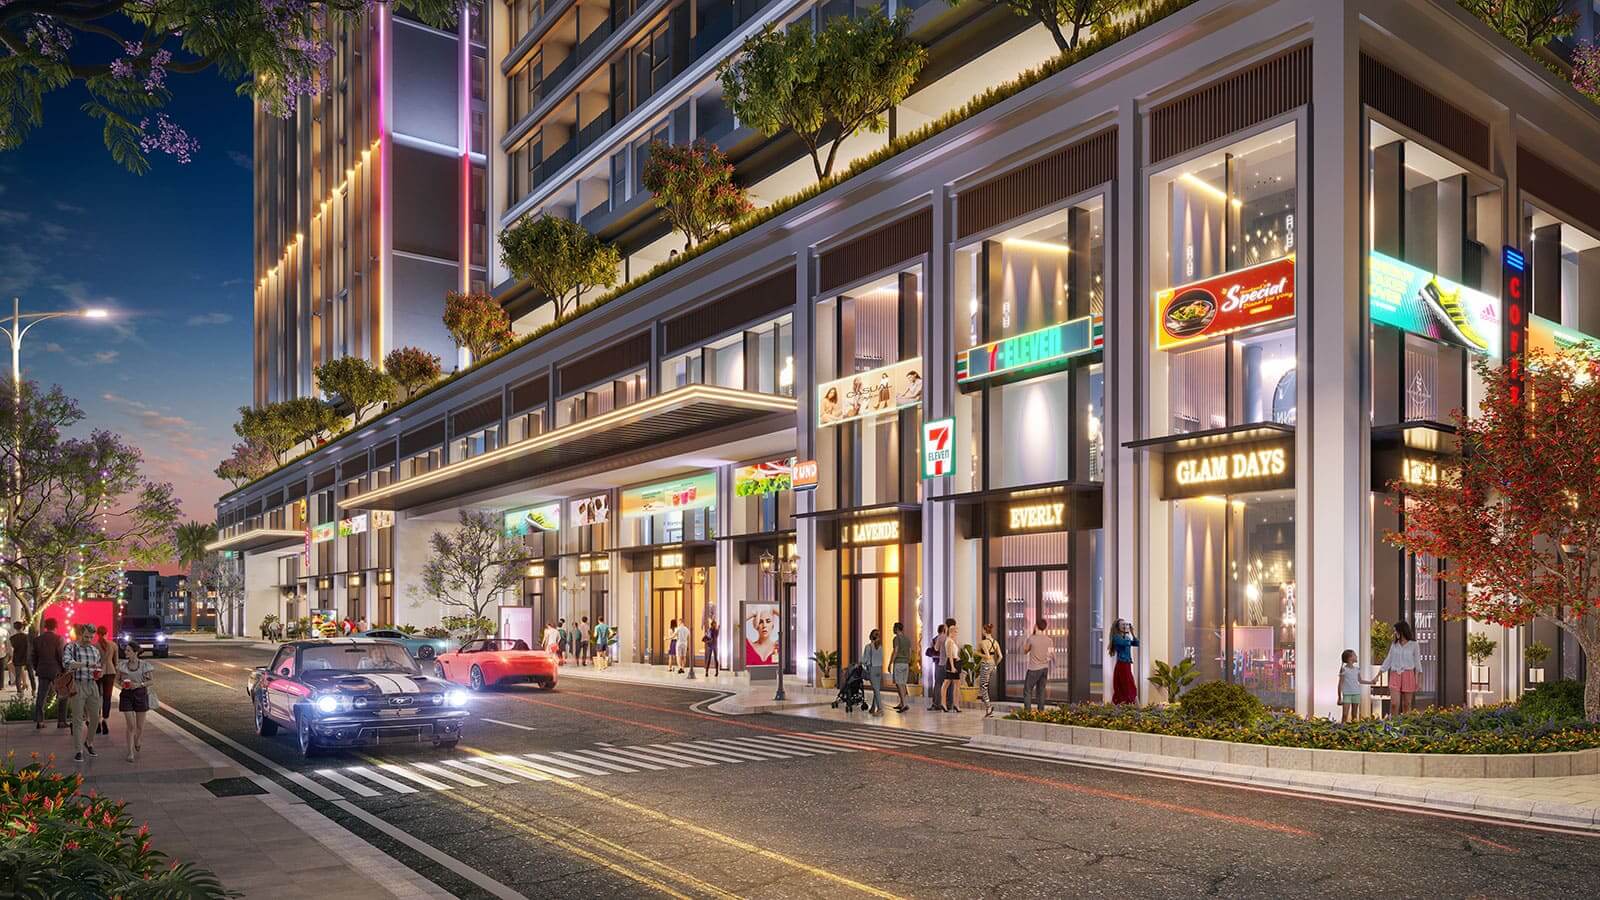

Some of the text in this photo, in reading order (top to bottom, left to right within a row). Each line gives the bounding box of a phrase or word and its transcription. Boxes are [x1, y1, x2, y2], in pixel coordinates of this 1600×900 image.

[1221, 277, 1288, 312] Special
[1175, 447, 1286, 485] GLAM DAYS
[1009, 502, 1065, 529] EVERLY
